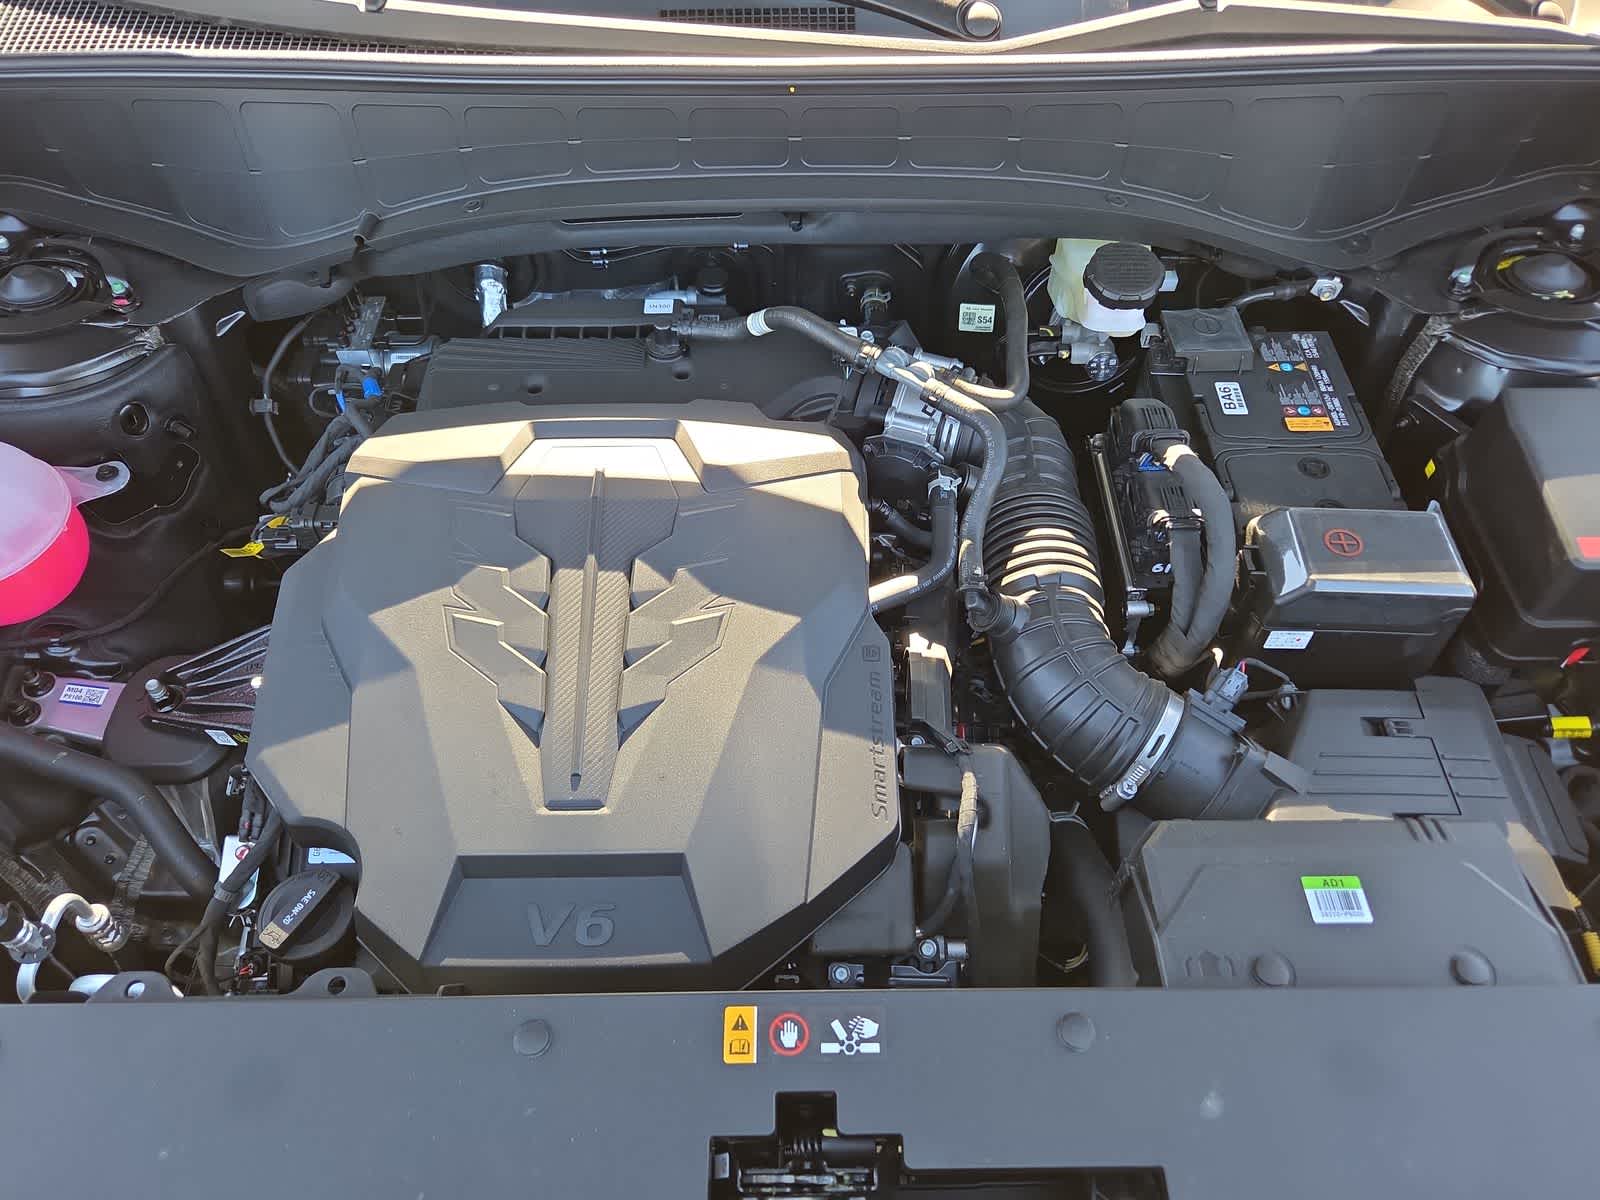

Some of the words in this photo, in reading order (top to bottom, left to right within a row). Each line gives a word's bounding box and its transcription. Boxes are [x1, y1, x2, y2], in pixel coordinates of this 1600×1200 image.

[977, 316, 992, 324] S54
[1218, 387, 1237, 410] BA6
[870, 671, 889, 821] Smartstream
[1322, 878, 1345, 888] AD1
[300, 889, 316, 905] SAE
[283, 902, 304, 925] 0W-20
[527, 902, 617, 947] V6
